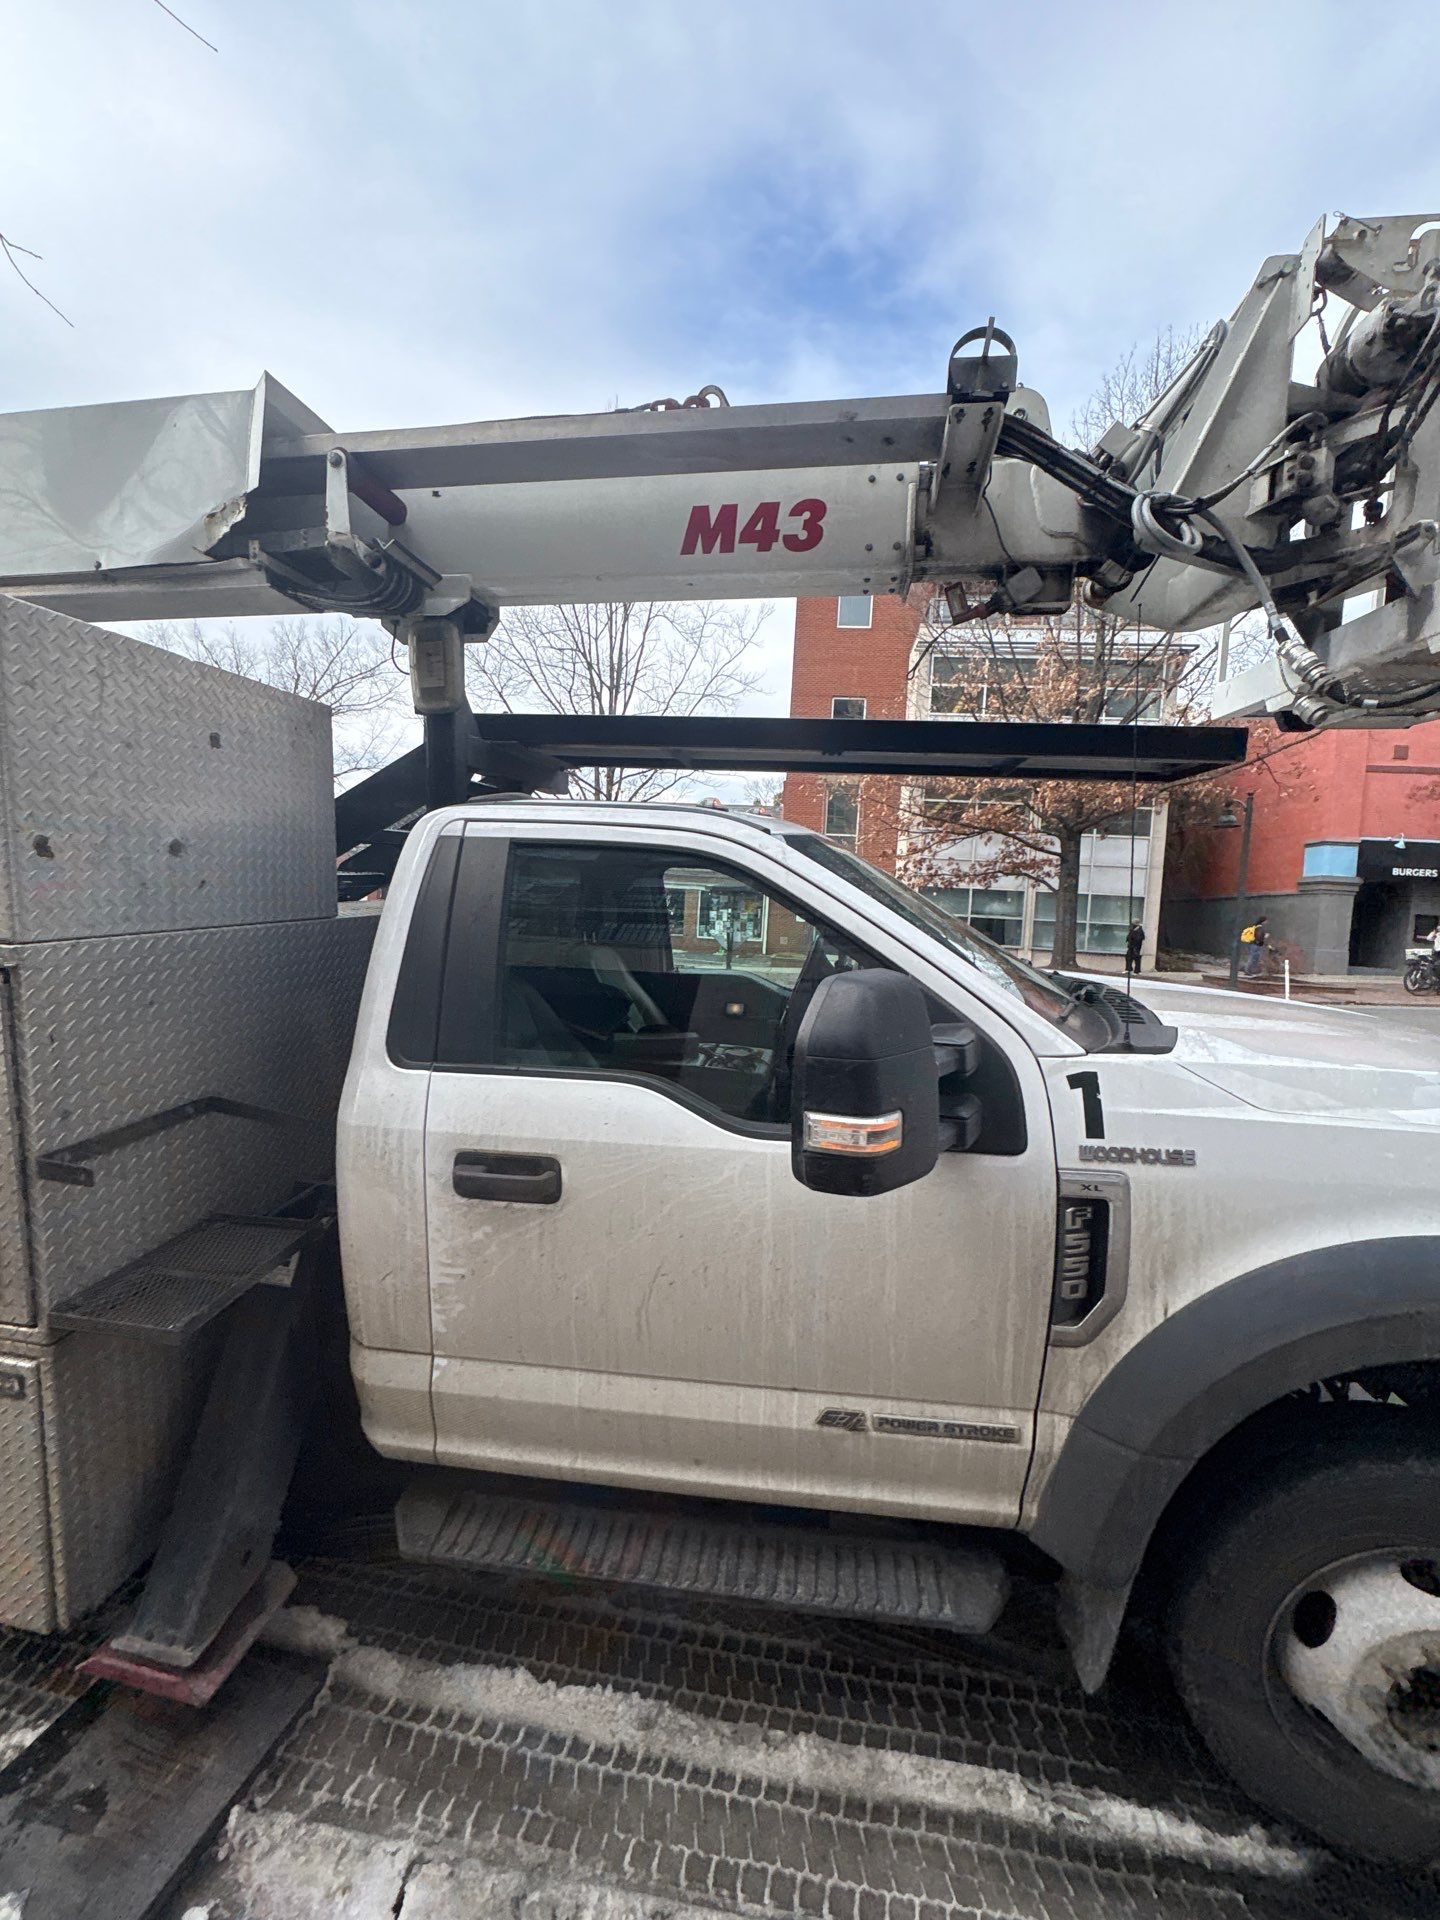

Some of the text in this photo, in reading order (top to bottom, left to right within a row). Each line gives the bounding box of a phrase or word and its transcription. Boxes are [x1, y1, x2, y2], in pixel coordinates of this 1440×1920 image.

[680, 498, 827, 555] M43
[1392, 867, 1438, 877] BURGERS
[1066, 1071, 1105, 1139] 1
[1079, 1145, 1196, 1167] WOODHOUSE
[1081, 1184, 1103, 1192] XL
[877, 1416, 940, 1433] POWER
[943, 1421, 1016, 1439] STROKE
